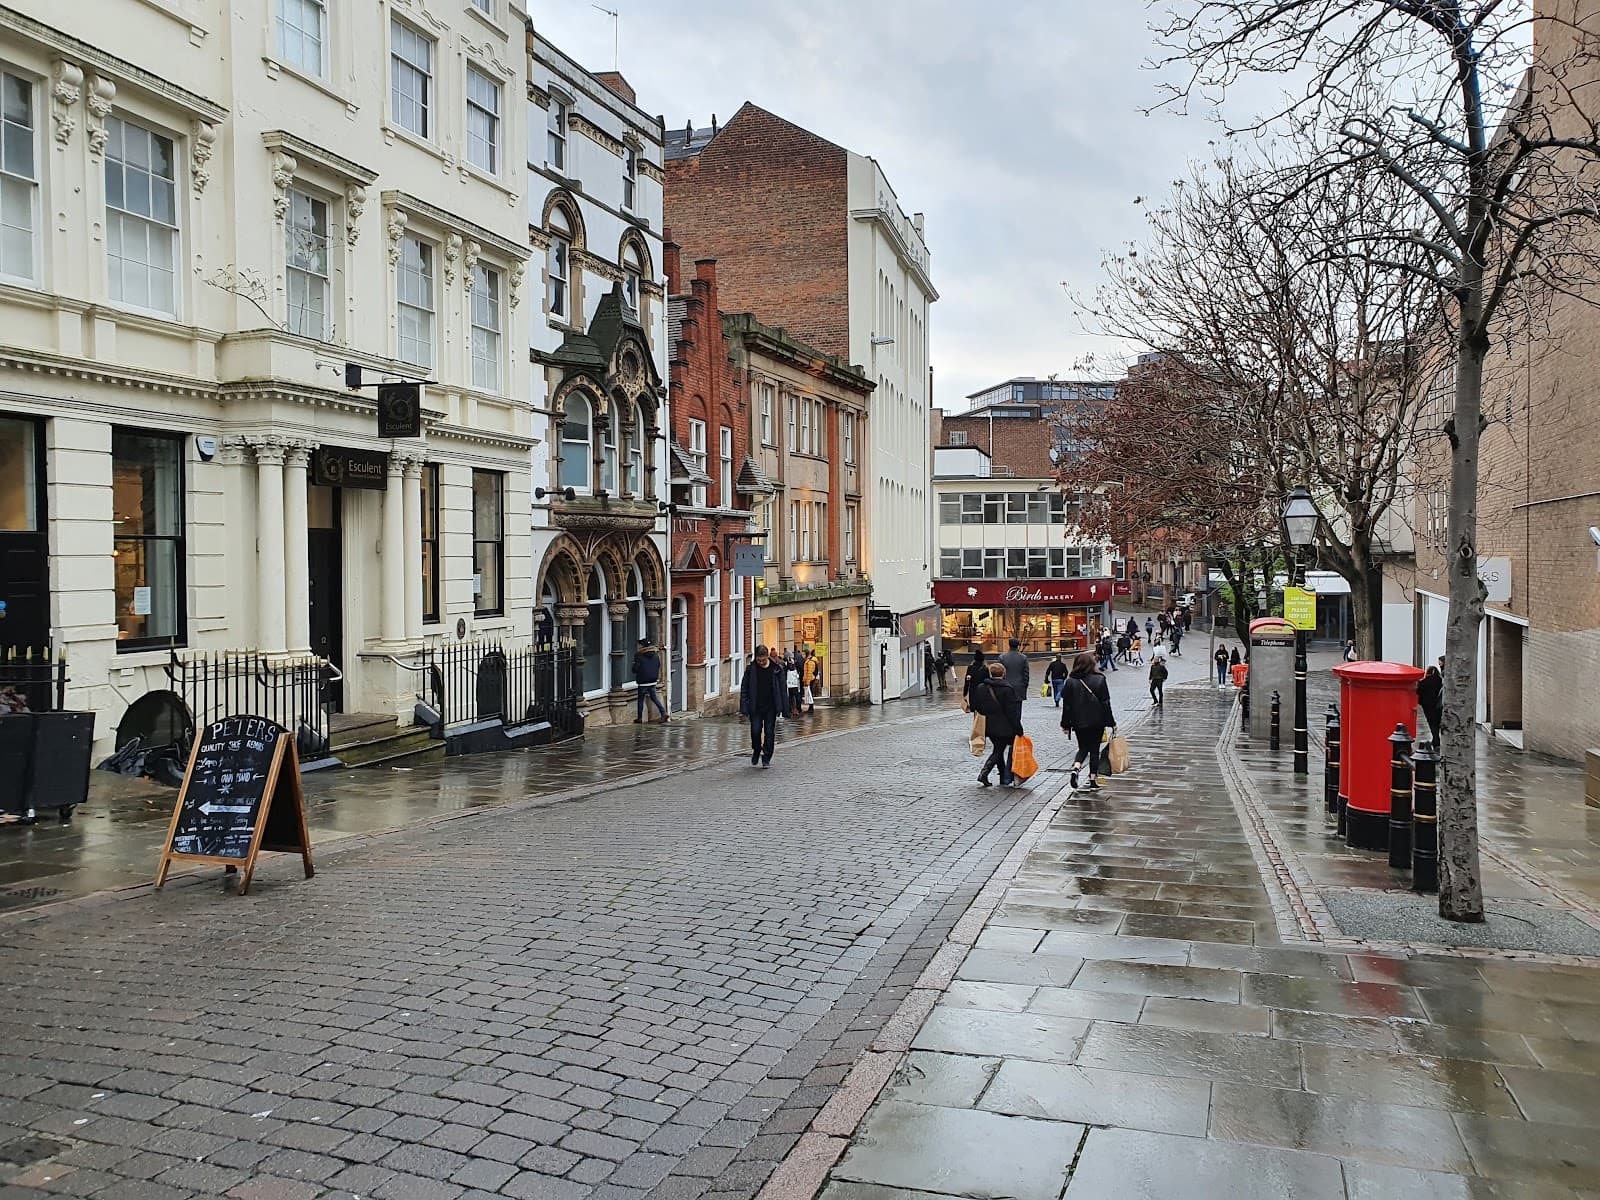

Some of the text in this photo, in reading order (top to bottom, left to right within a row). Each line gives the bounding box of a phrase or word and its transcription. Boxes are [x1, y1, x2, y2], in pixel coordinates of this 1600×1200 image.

[348, 460, 382, 474] Esculent
[1005, 585, 1042, 601] Birds
[1260, 639, 1286, 647] Telephone
[211, 718, 276, 743] PETERS
